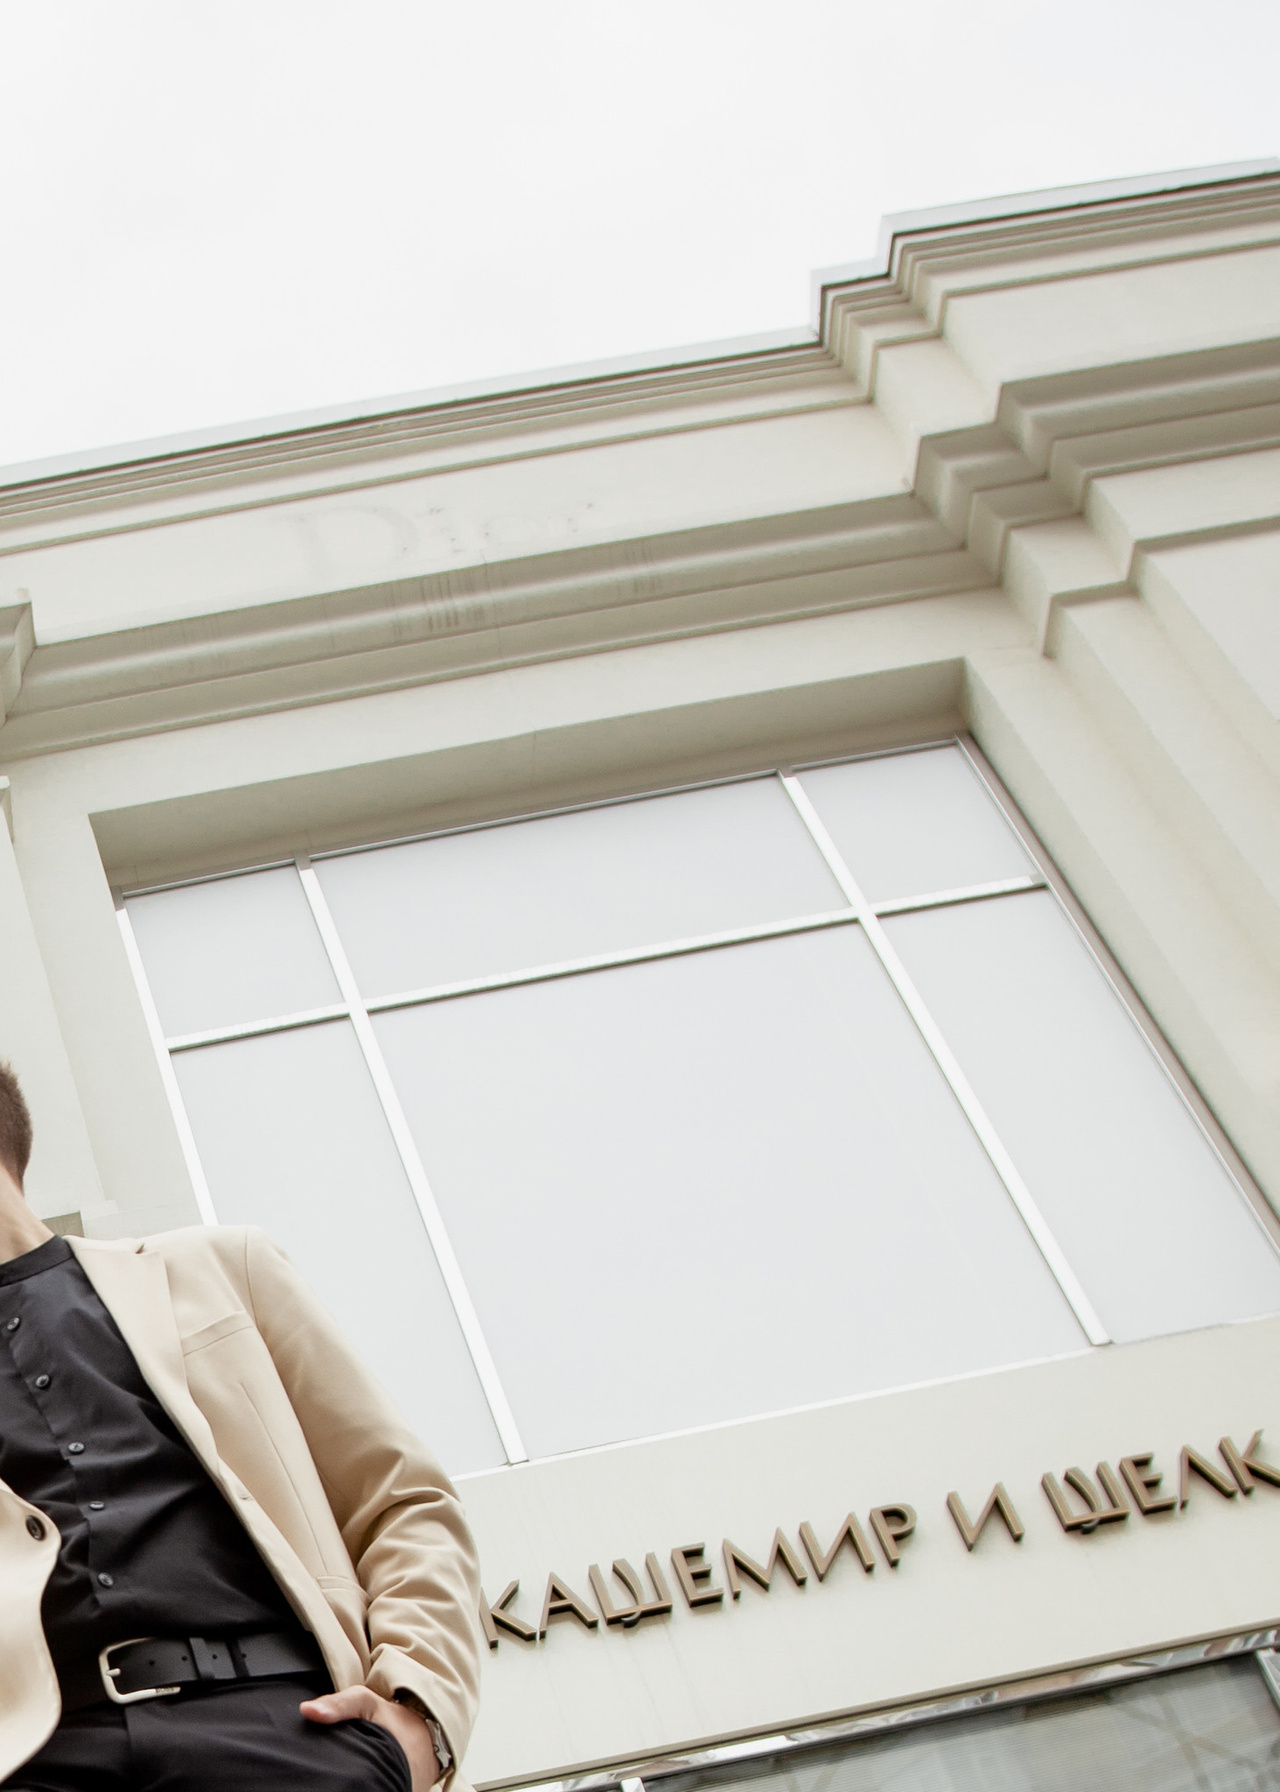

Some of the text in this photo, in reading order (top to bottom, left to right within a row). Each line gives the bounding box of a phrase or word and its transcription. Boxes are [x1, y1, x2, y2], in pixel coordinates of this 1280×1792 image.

[479, 1428, 1280, 1650] КАШЕМИР И ШЕЛК
